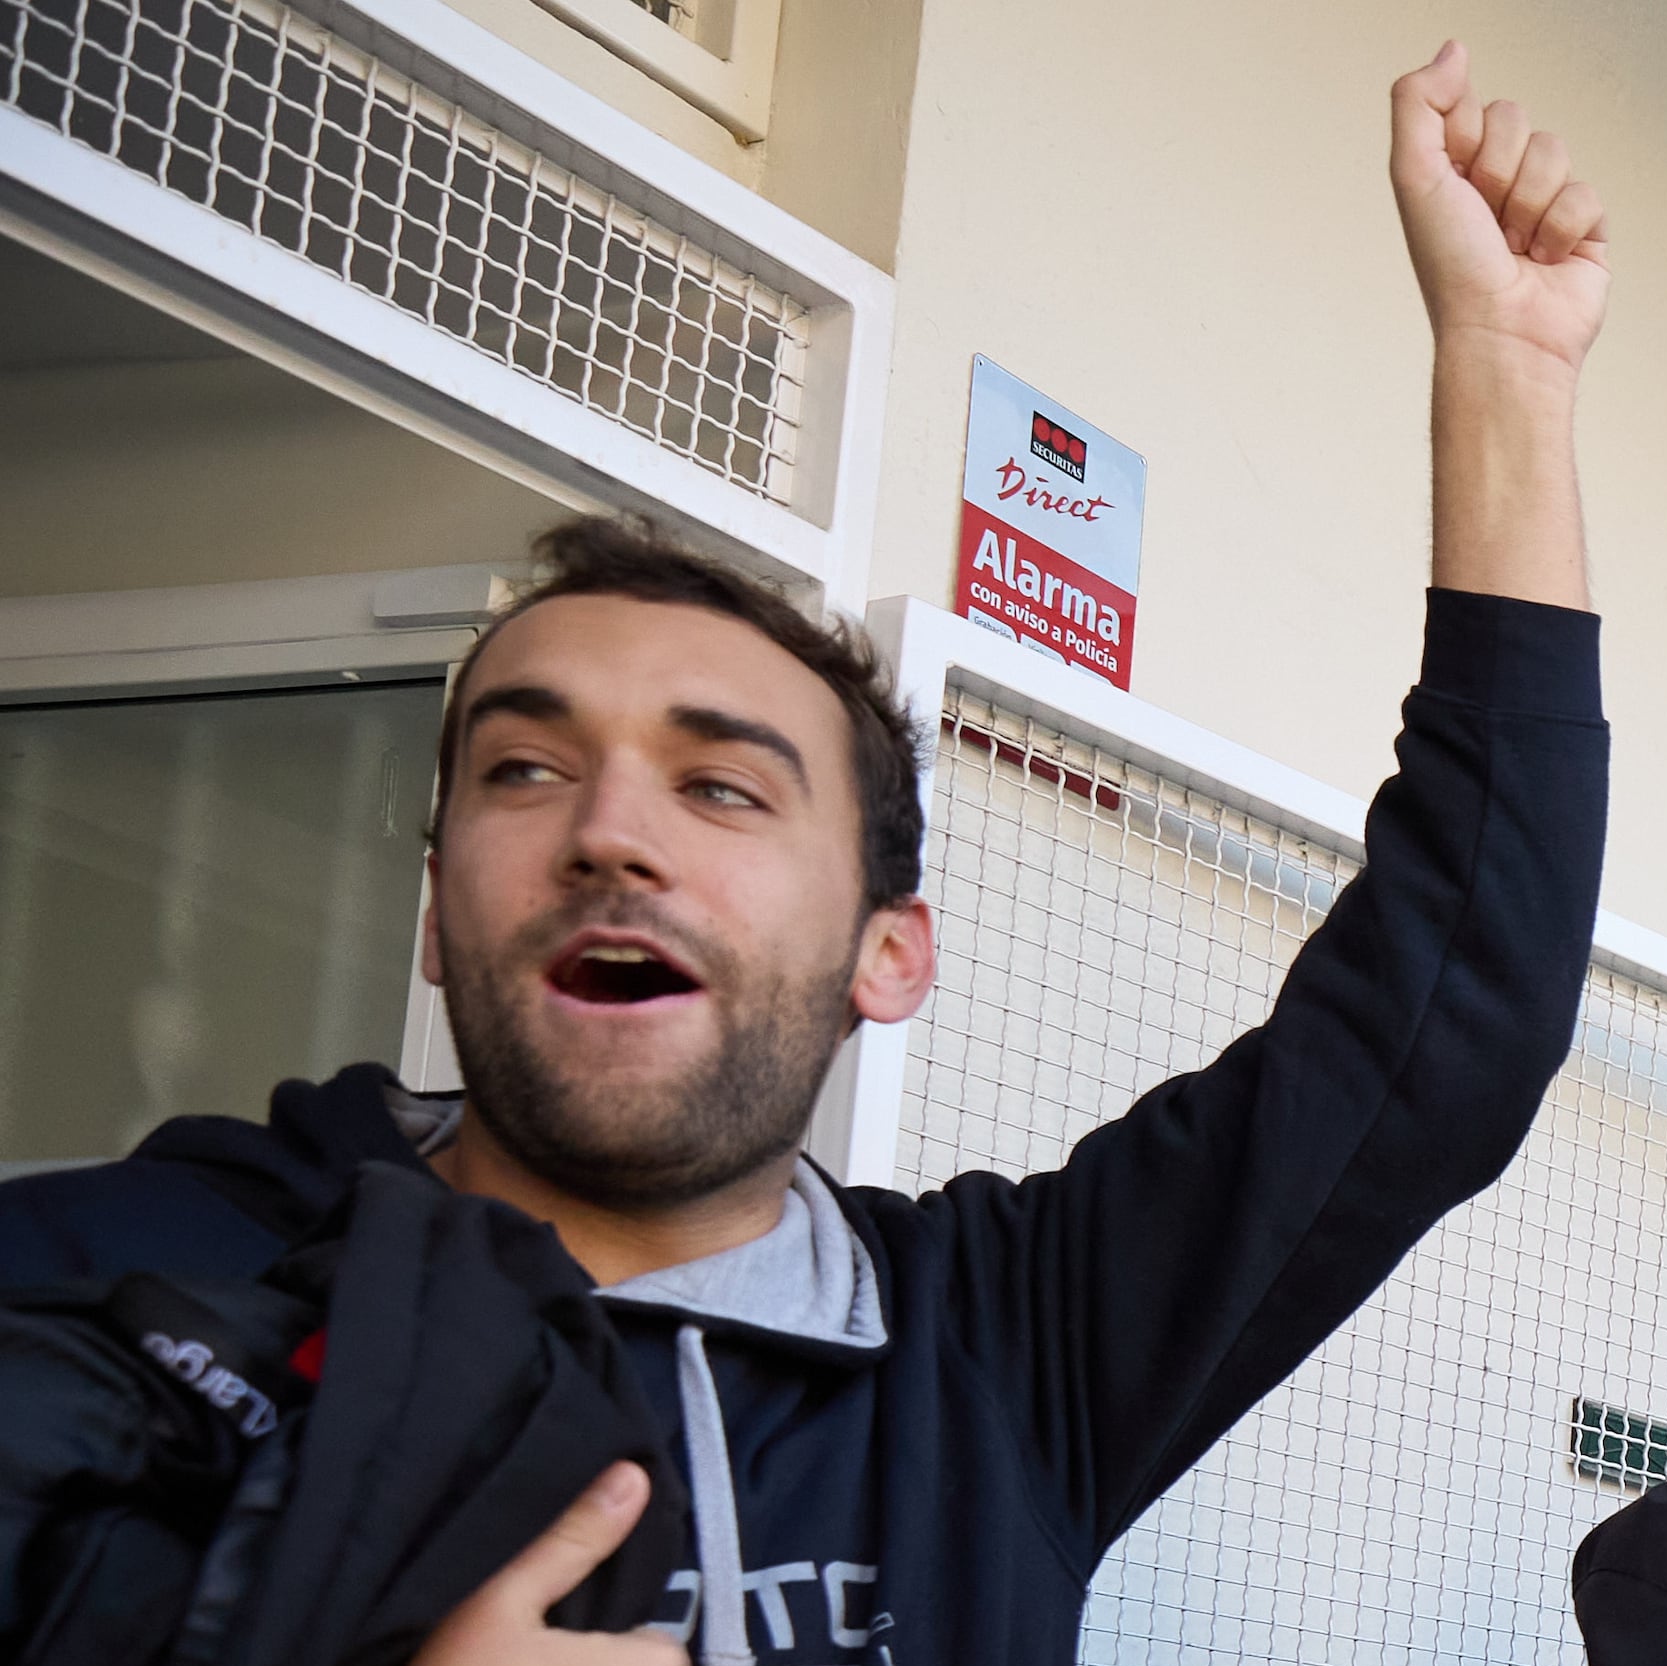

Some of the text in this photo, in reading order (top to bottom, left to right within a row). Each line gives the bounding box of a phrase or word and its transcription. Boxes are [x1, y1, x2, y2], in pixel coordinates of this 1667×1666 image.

[995, 456, 1117, 523] Direct
[1032, 441, 1084, 480] SECURITAS
[972, 528, 1121, 647] Alarma
[970, 582, 1002, 609] con
[1004, 599, 1049, 634] aviso
[1051, 626, 1062, 642] a
[1065, 628, 1118, 673] Policía
